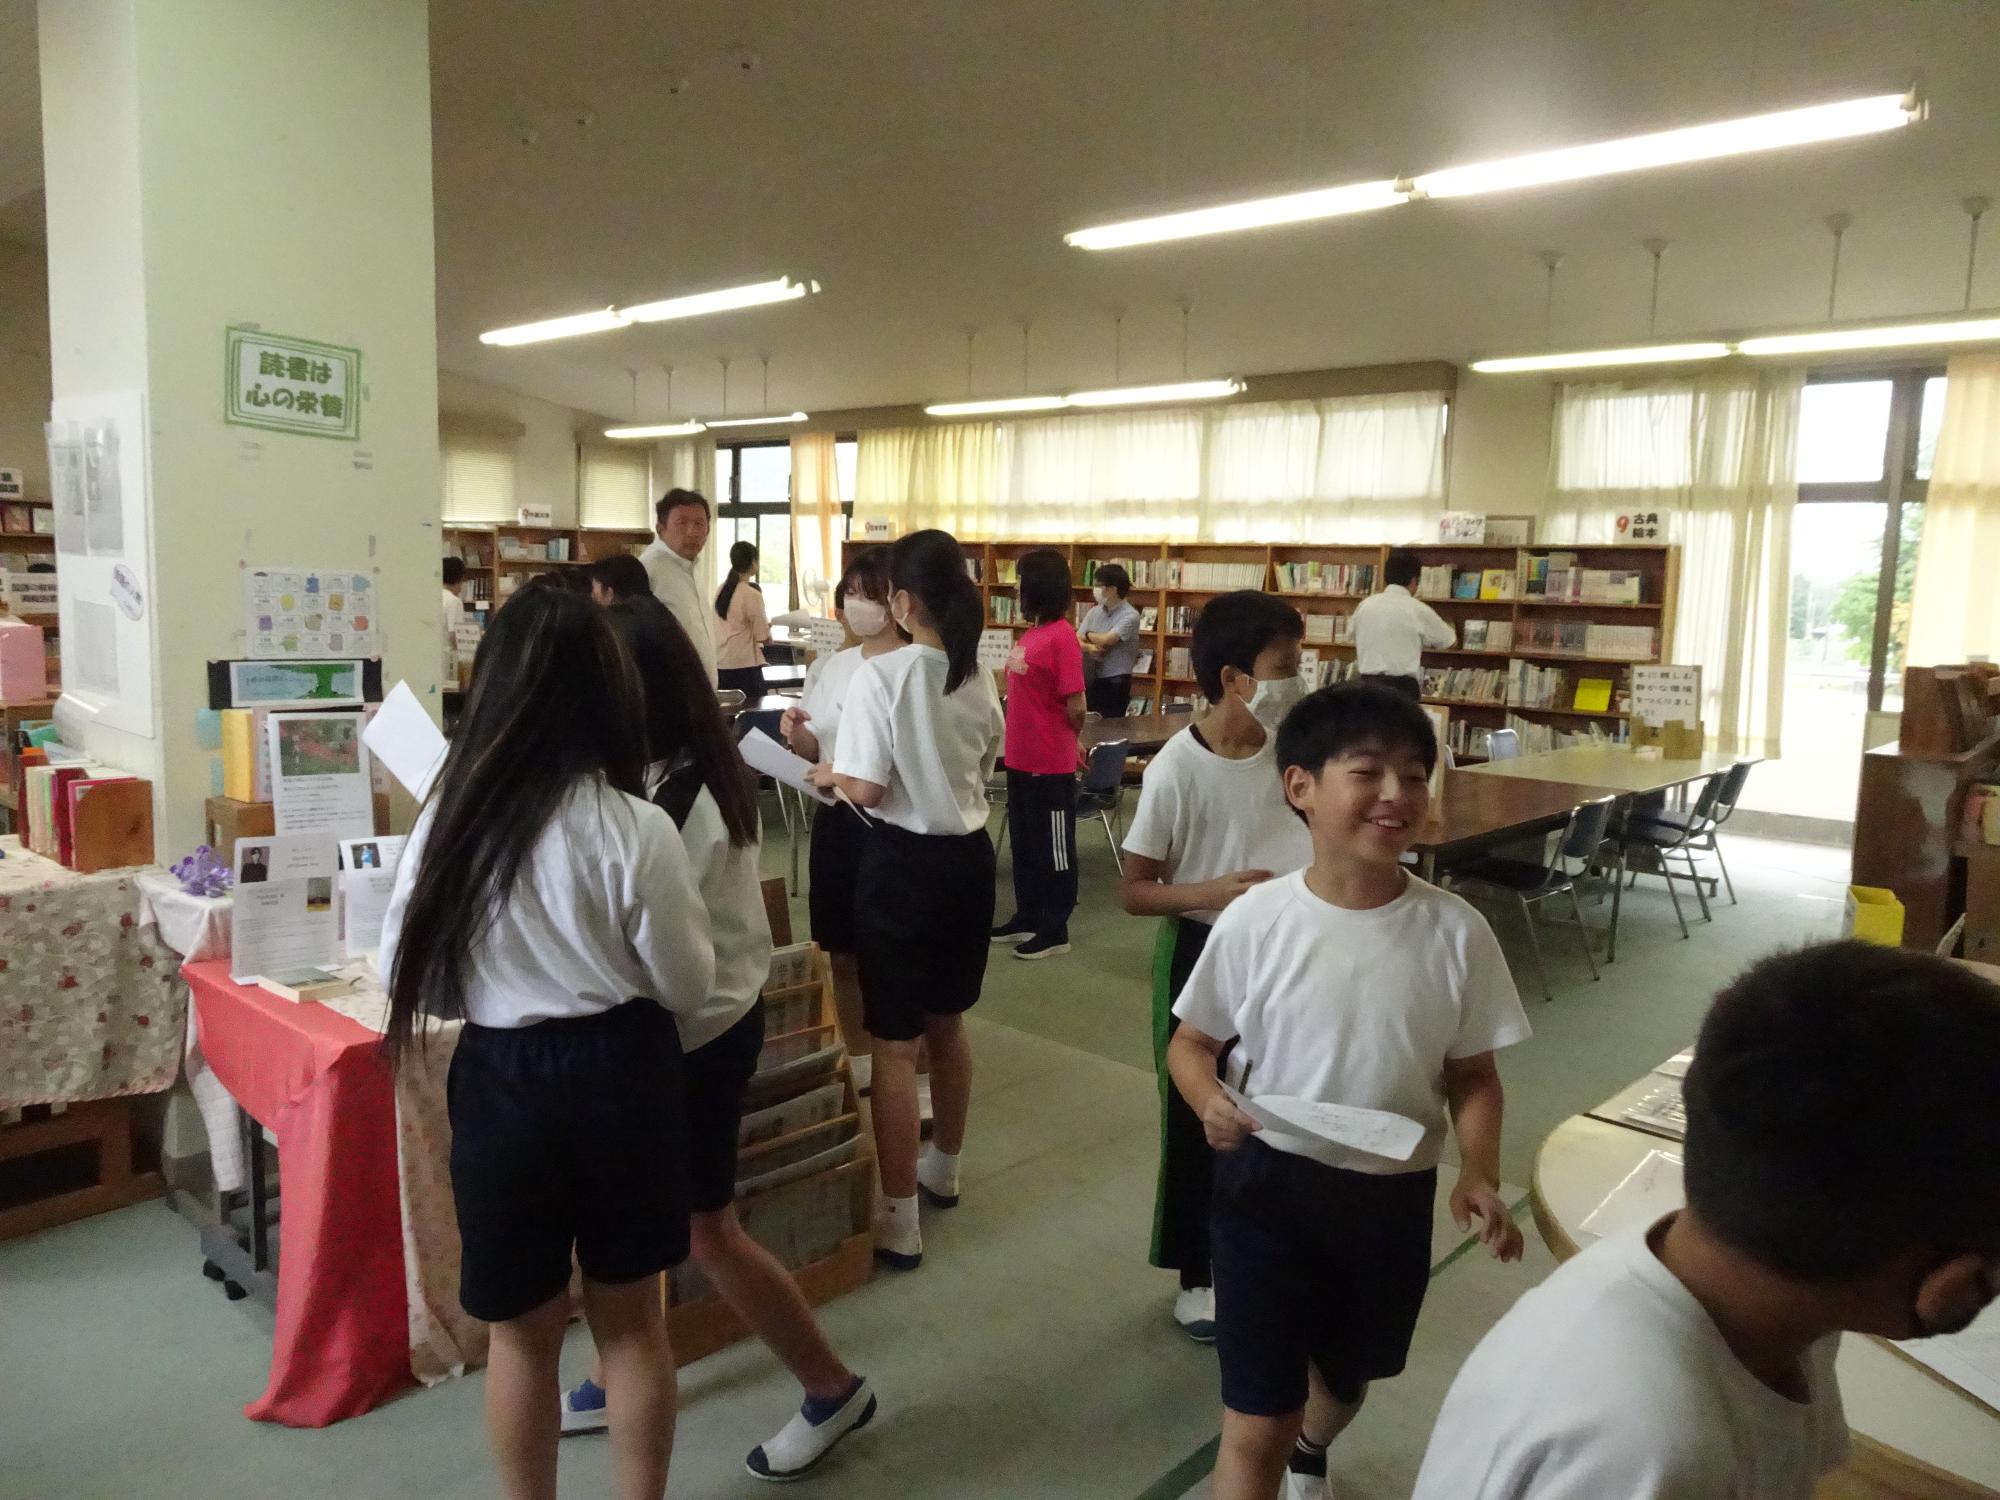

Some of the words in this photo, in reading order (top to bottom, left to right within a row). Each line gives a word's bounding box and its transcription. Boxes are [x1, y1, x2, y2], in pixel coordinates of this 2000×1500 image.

[259, 350, 332, 384] 読書は
[245, 382, 343, 419] 心の栄養
[1616, 515, 1630, 533] 9
[1633, 512, 1658, 525] 古典
[1632, 527, 1658, 539] 絵本
